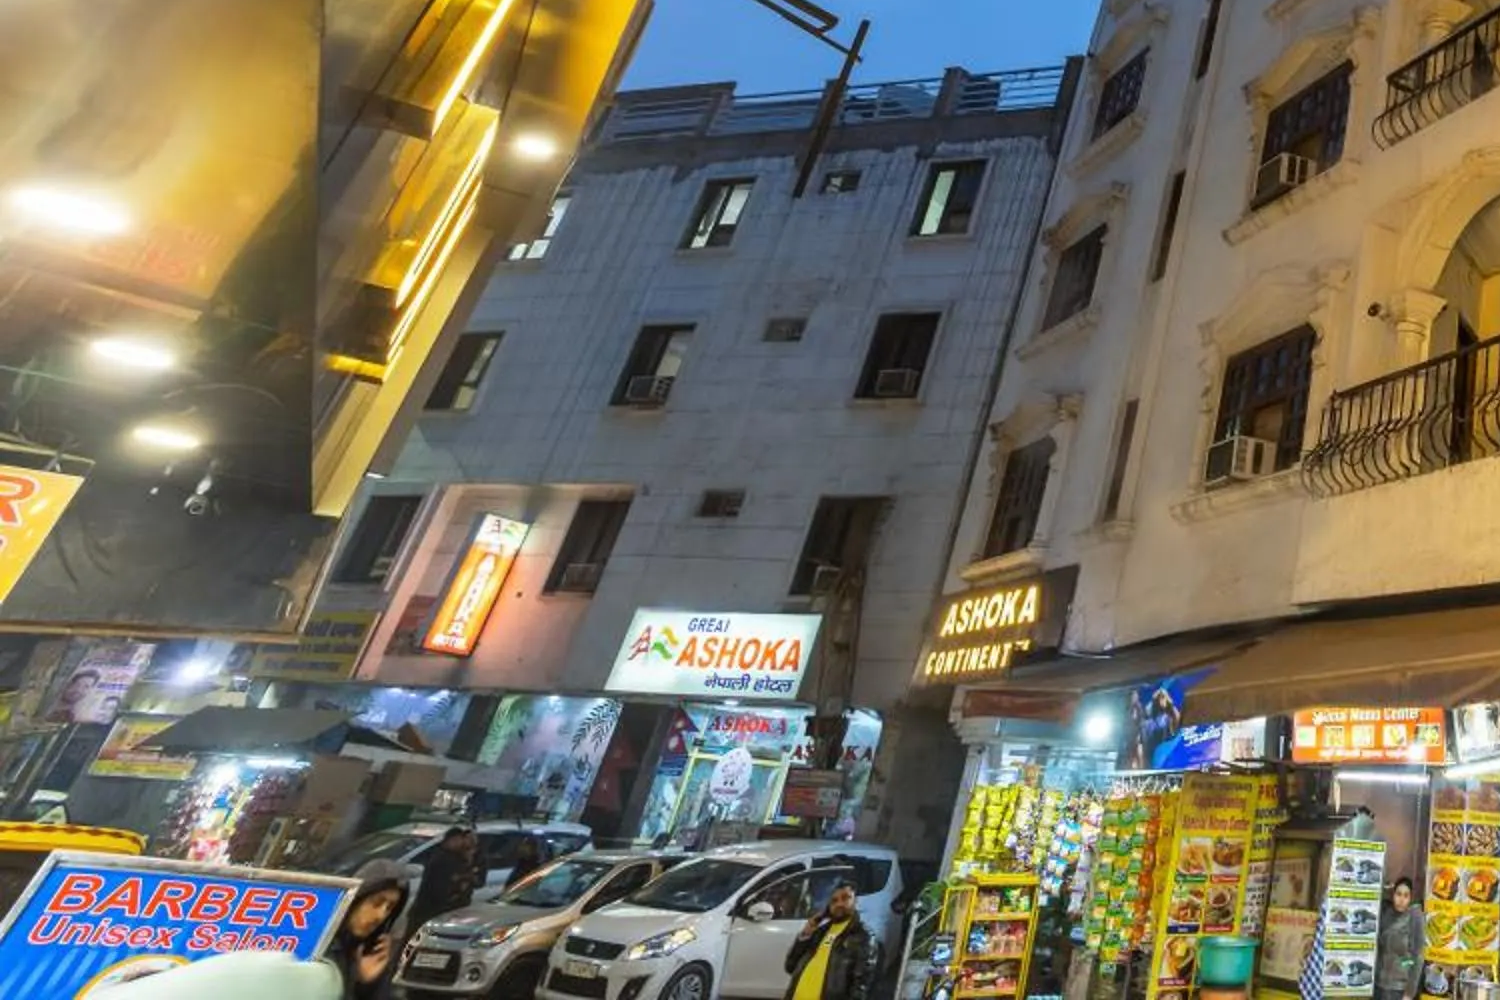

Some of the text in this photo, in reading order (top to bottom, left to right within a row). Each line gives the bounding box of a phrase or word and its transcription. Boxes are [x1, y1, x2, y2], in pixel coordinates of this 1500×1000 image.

[940, 585, 1038, 637] ASHOKA
[675, 635, 801, 672] ASHOKA
[707, 713, 787, 736] ASHOKA
[790, 743, 874, 764] ASKA
[45, 873, 319, 930] BARBER
[28, 914, 300, 953] Unisex Salon
